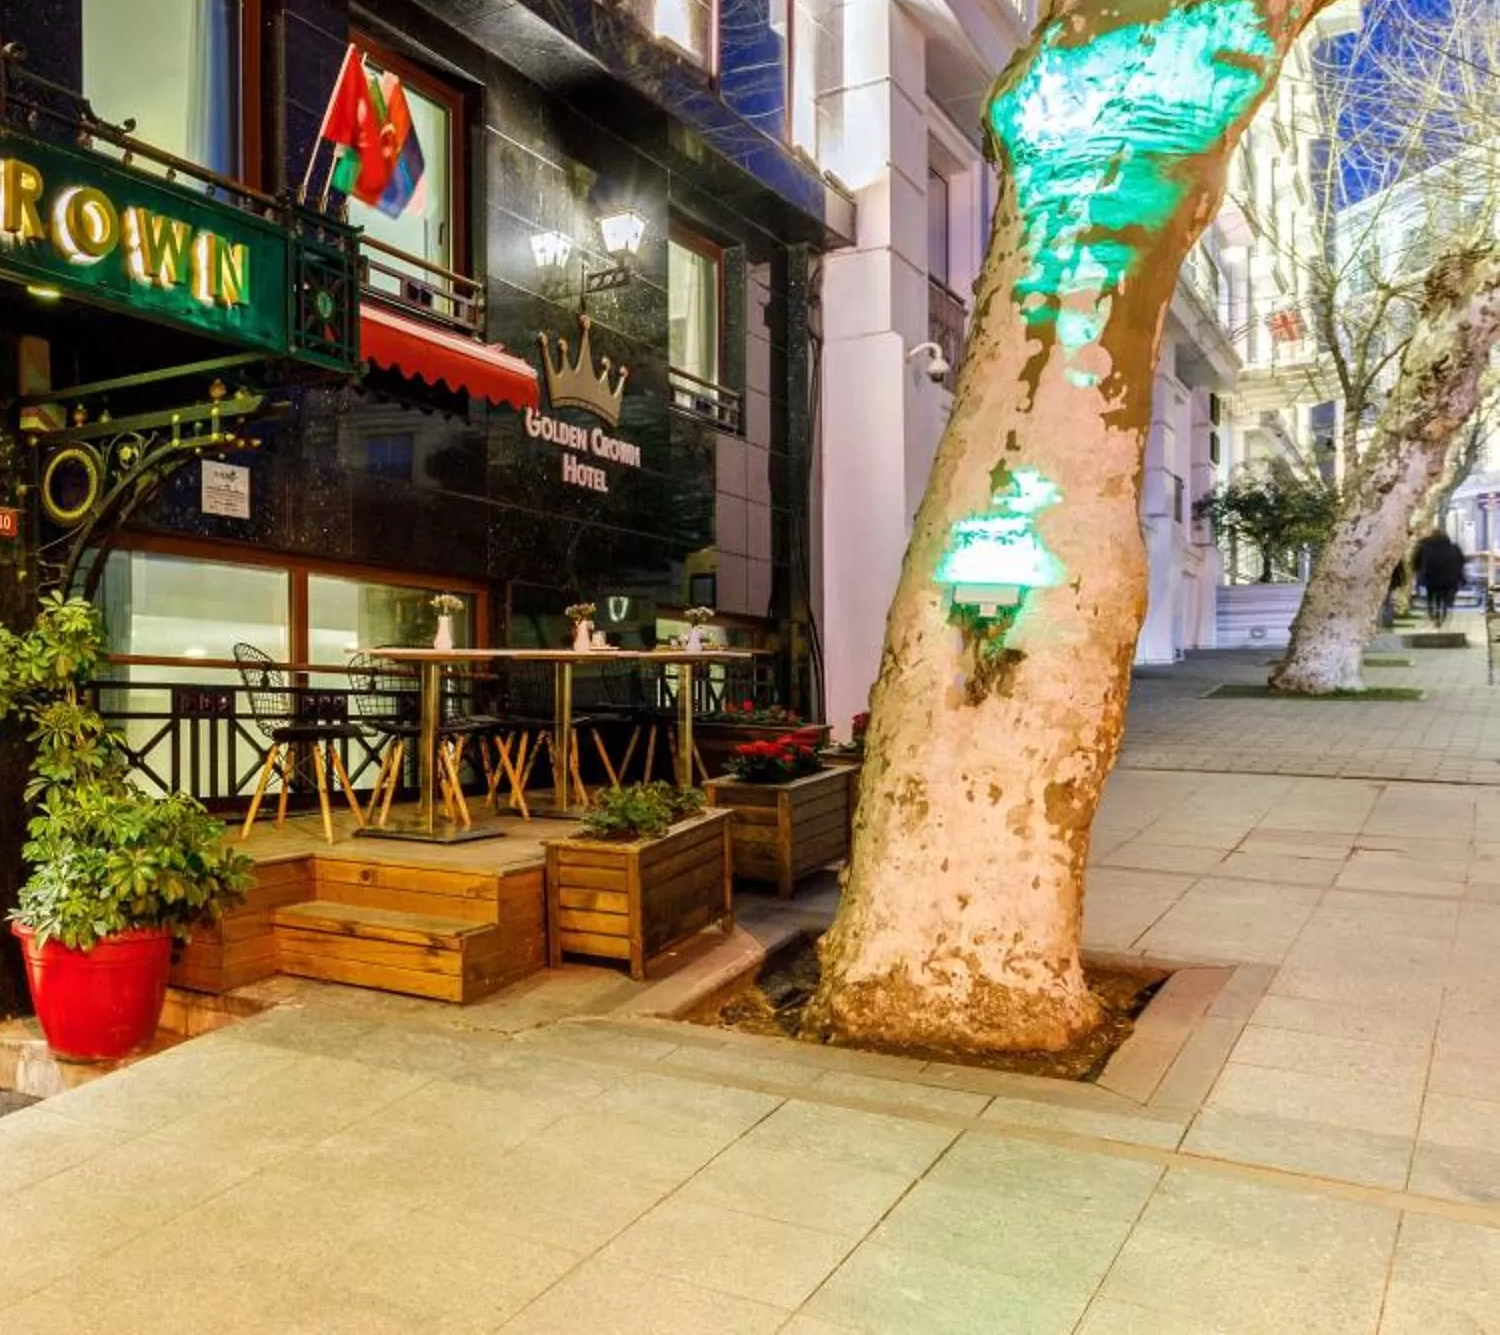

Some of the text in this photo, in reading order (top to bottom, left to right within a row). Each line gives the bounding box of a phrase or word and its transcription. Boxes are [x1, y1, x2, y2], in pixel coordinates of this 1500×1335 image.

[525, 406, 641, 468] GOLDEN CROWN
[563, 452, 609, 493] HOTEL
